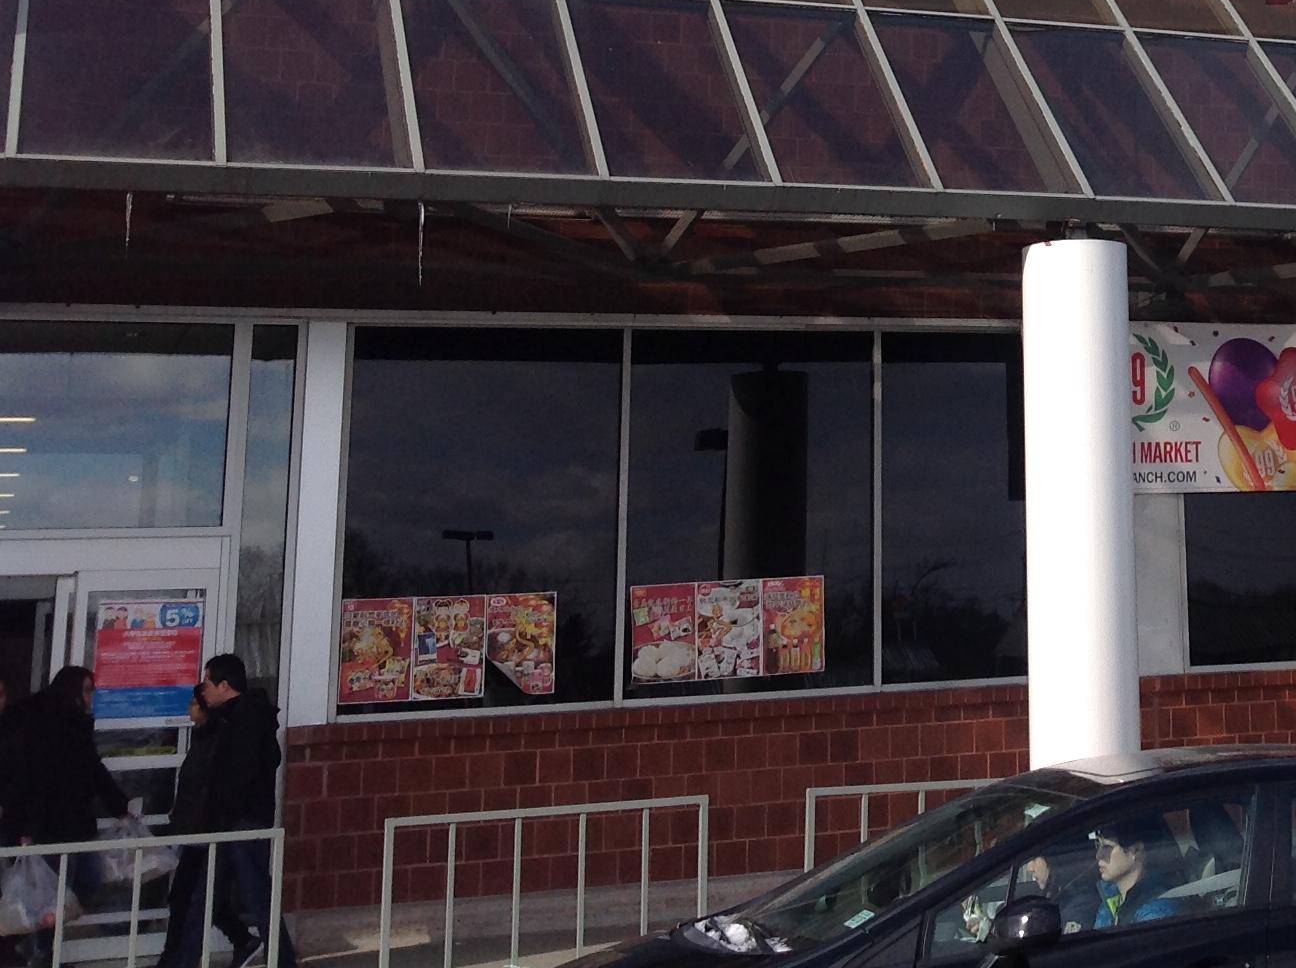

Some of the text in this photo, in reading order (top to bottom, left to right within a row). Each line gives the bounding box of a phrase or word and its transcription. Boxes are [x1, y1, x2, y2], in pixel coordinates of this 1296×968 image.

[1140, 440, 1202, 464] MARKET
[1133, 470, 1197, 484] ANCH.COM
[166, 609, 180, 627] 5
